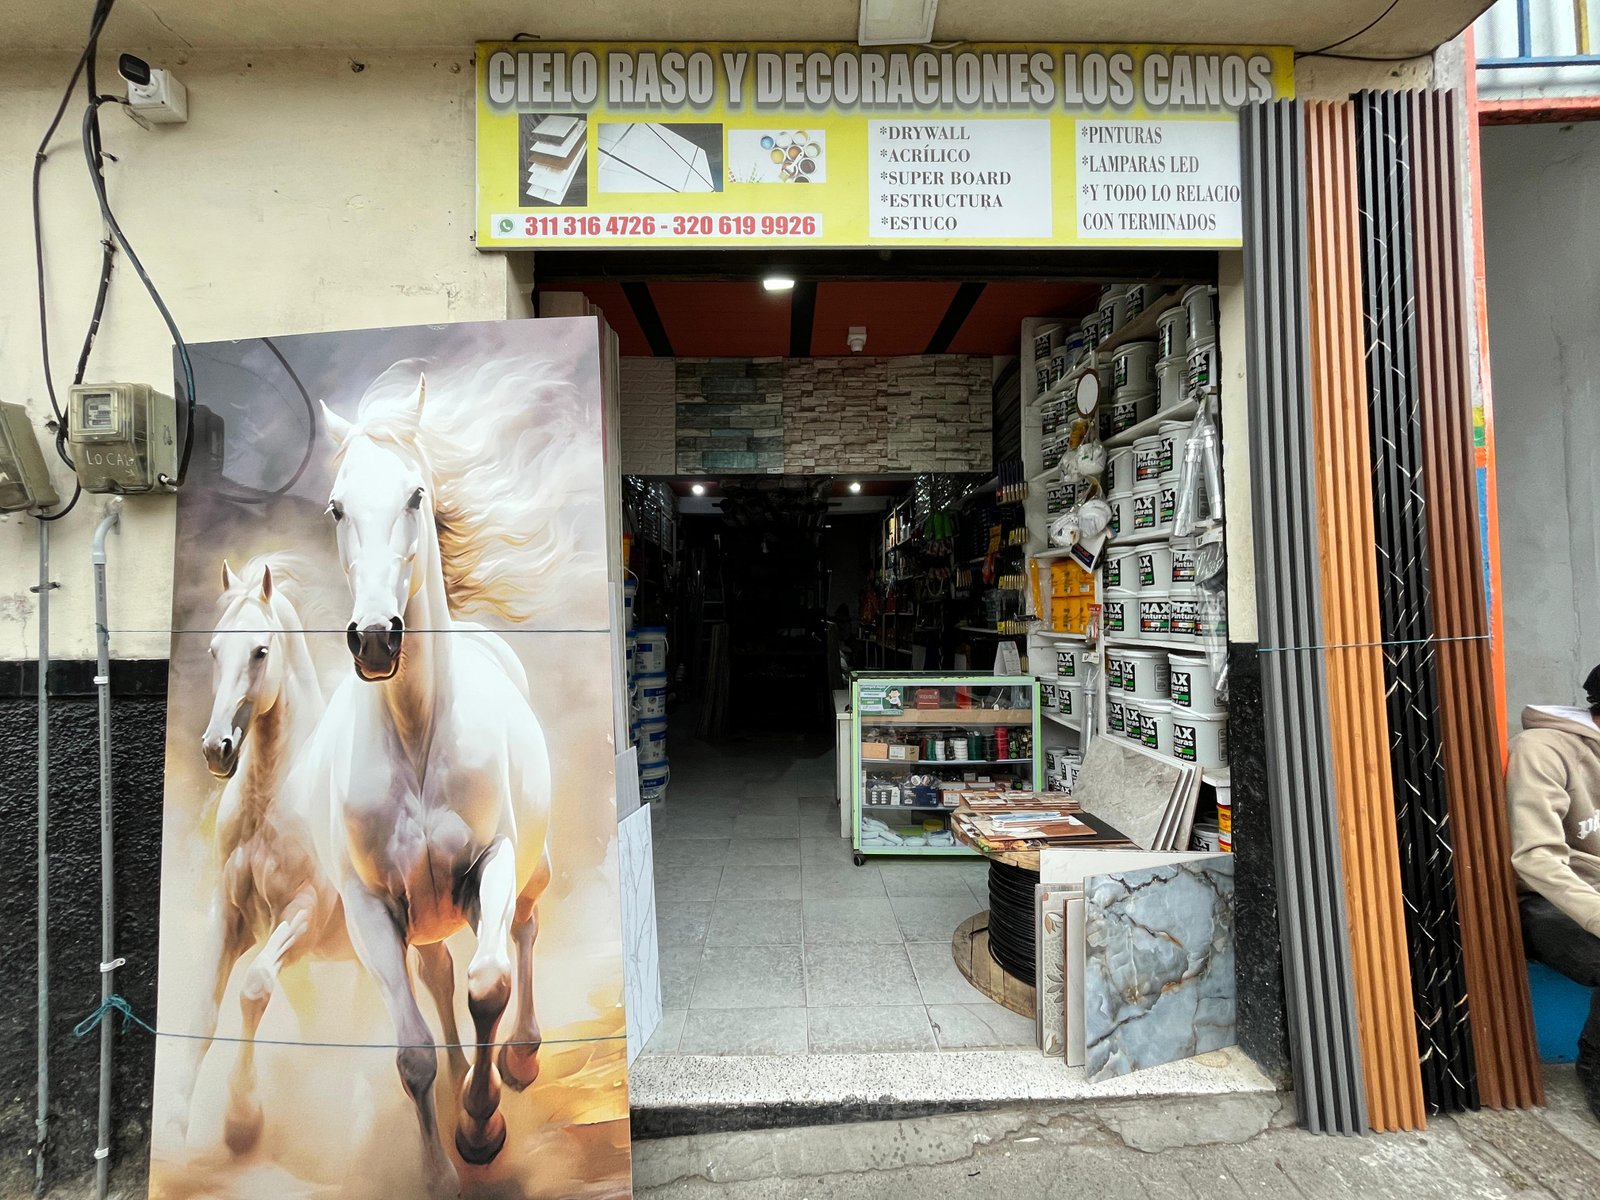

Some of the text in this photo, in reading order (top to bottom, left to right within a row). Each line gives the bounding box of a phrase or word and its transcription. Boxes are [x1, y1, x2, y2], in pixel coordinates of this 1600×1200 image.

[488, 52, 1273, 107] CIELO RASO Y DECORACIONES LOS CANOS
[1171, 156, 1200, 173] LED
[950, 171, 1012, 186] BOARD
[1104, 184, 1147, 202] TODO
[1151, 185, 1172, 202] LO
[1176, 185, 1240, 202] RELACIO
[525, 216, 559, 236] 311
[564, 216, 601, 236] 316
[605, 216, 656, 236] 4726
[673, 216, 713, 235] 320
[718, 216, 756, 235] 619
[761, 216, 816, 235] 9926
[1082, 212, 1217, 231] CON TERMINADOS
[1140, 603, 1170, 614] MAX
[1171, 673, 1189, 686] AX
[1174, 726, 1193, 740] AX
